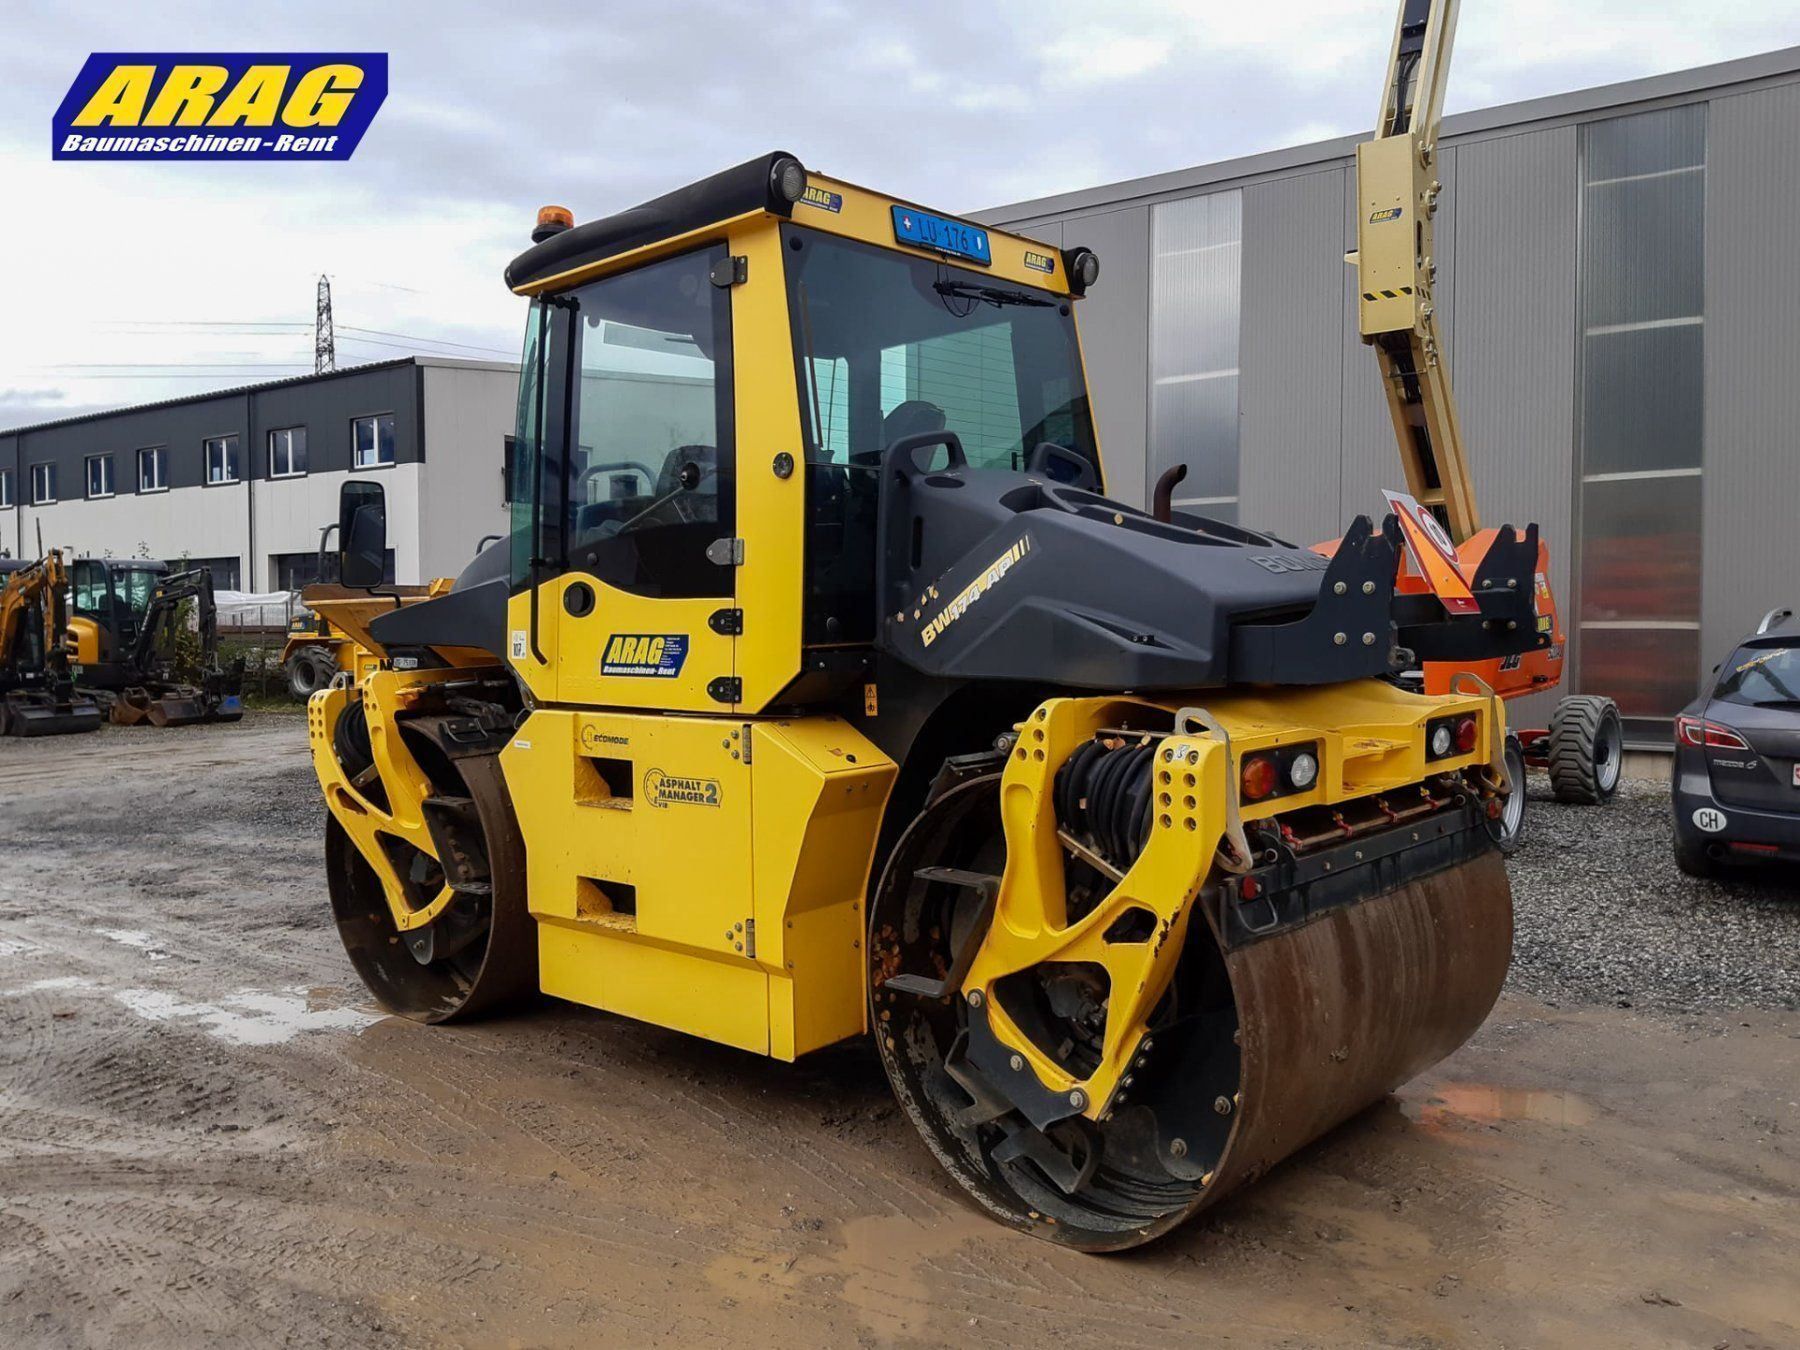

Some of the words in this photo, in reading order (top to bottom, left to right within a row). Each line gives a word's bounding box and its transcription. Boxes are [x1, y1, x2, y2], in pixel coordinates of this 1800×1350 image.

[1026, 252, 1047, 267] ARAG
[605, 637, 666, 665] ARAG
[659, 778, 702, 791] ASPHALT
[658, 789, 705, 803] MANAGER
[705, 783, 718, 804] 2
[1700, 811, 1719, 830] CH
